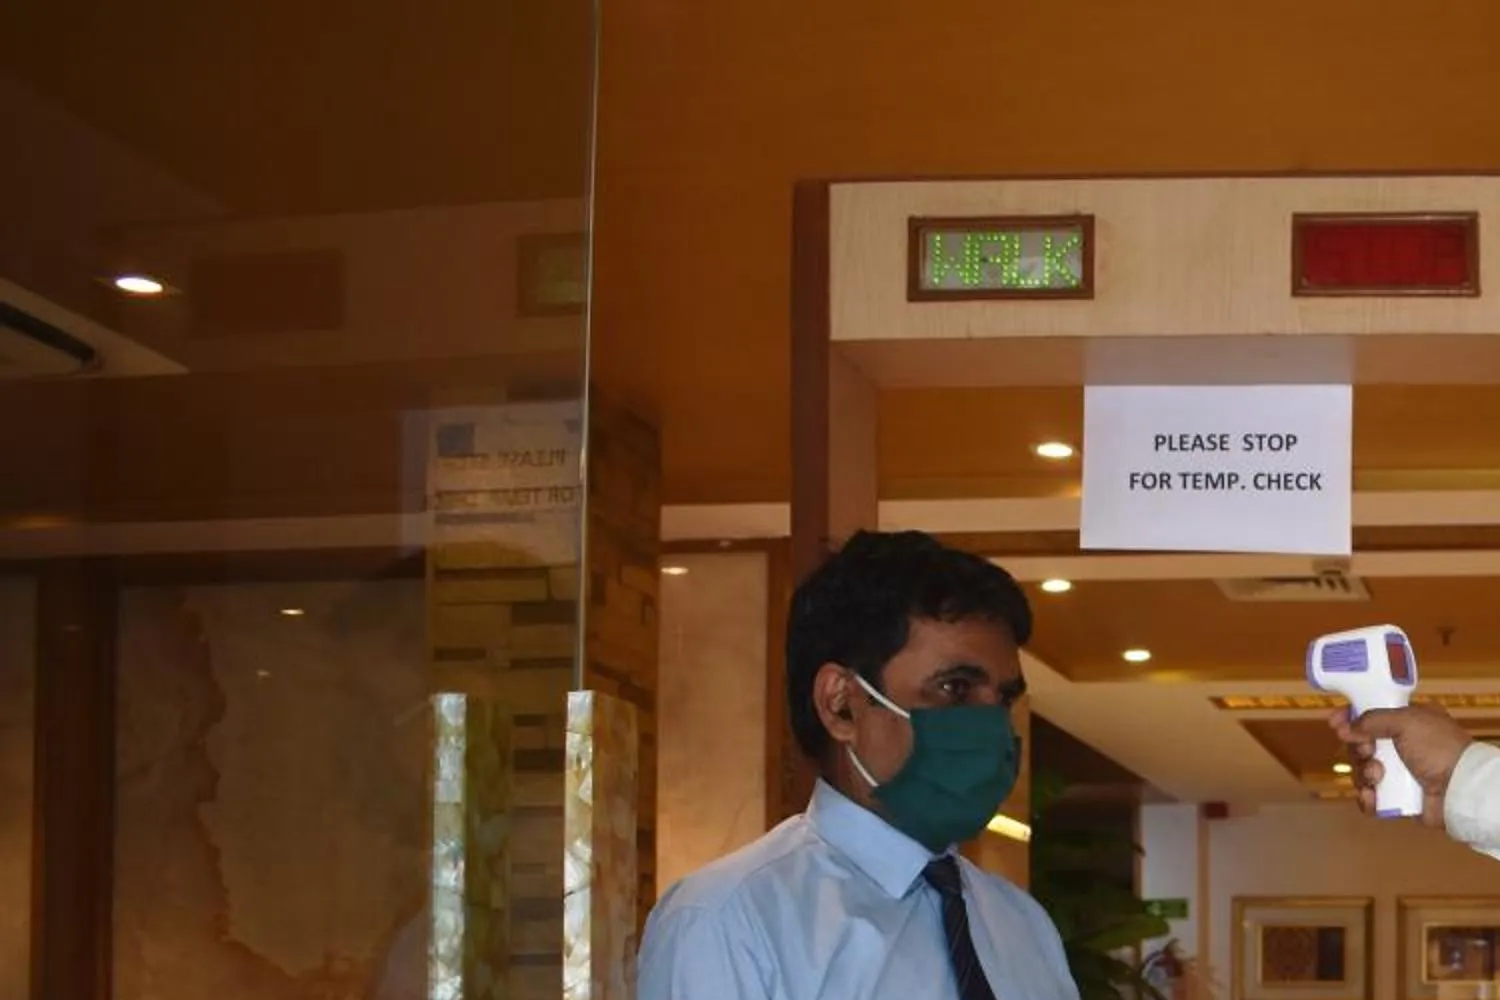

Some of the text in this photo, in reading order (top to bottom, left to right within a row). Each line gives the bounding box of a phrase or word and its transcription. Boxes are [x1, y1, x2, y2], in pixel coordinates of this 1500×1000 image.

[931, 232, 1079, 286] WALK
[1153, 433, 1298, 451] PLEASE STOP
[1128, 472, 1322, 491] FOR TEMP. CHECK
